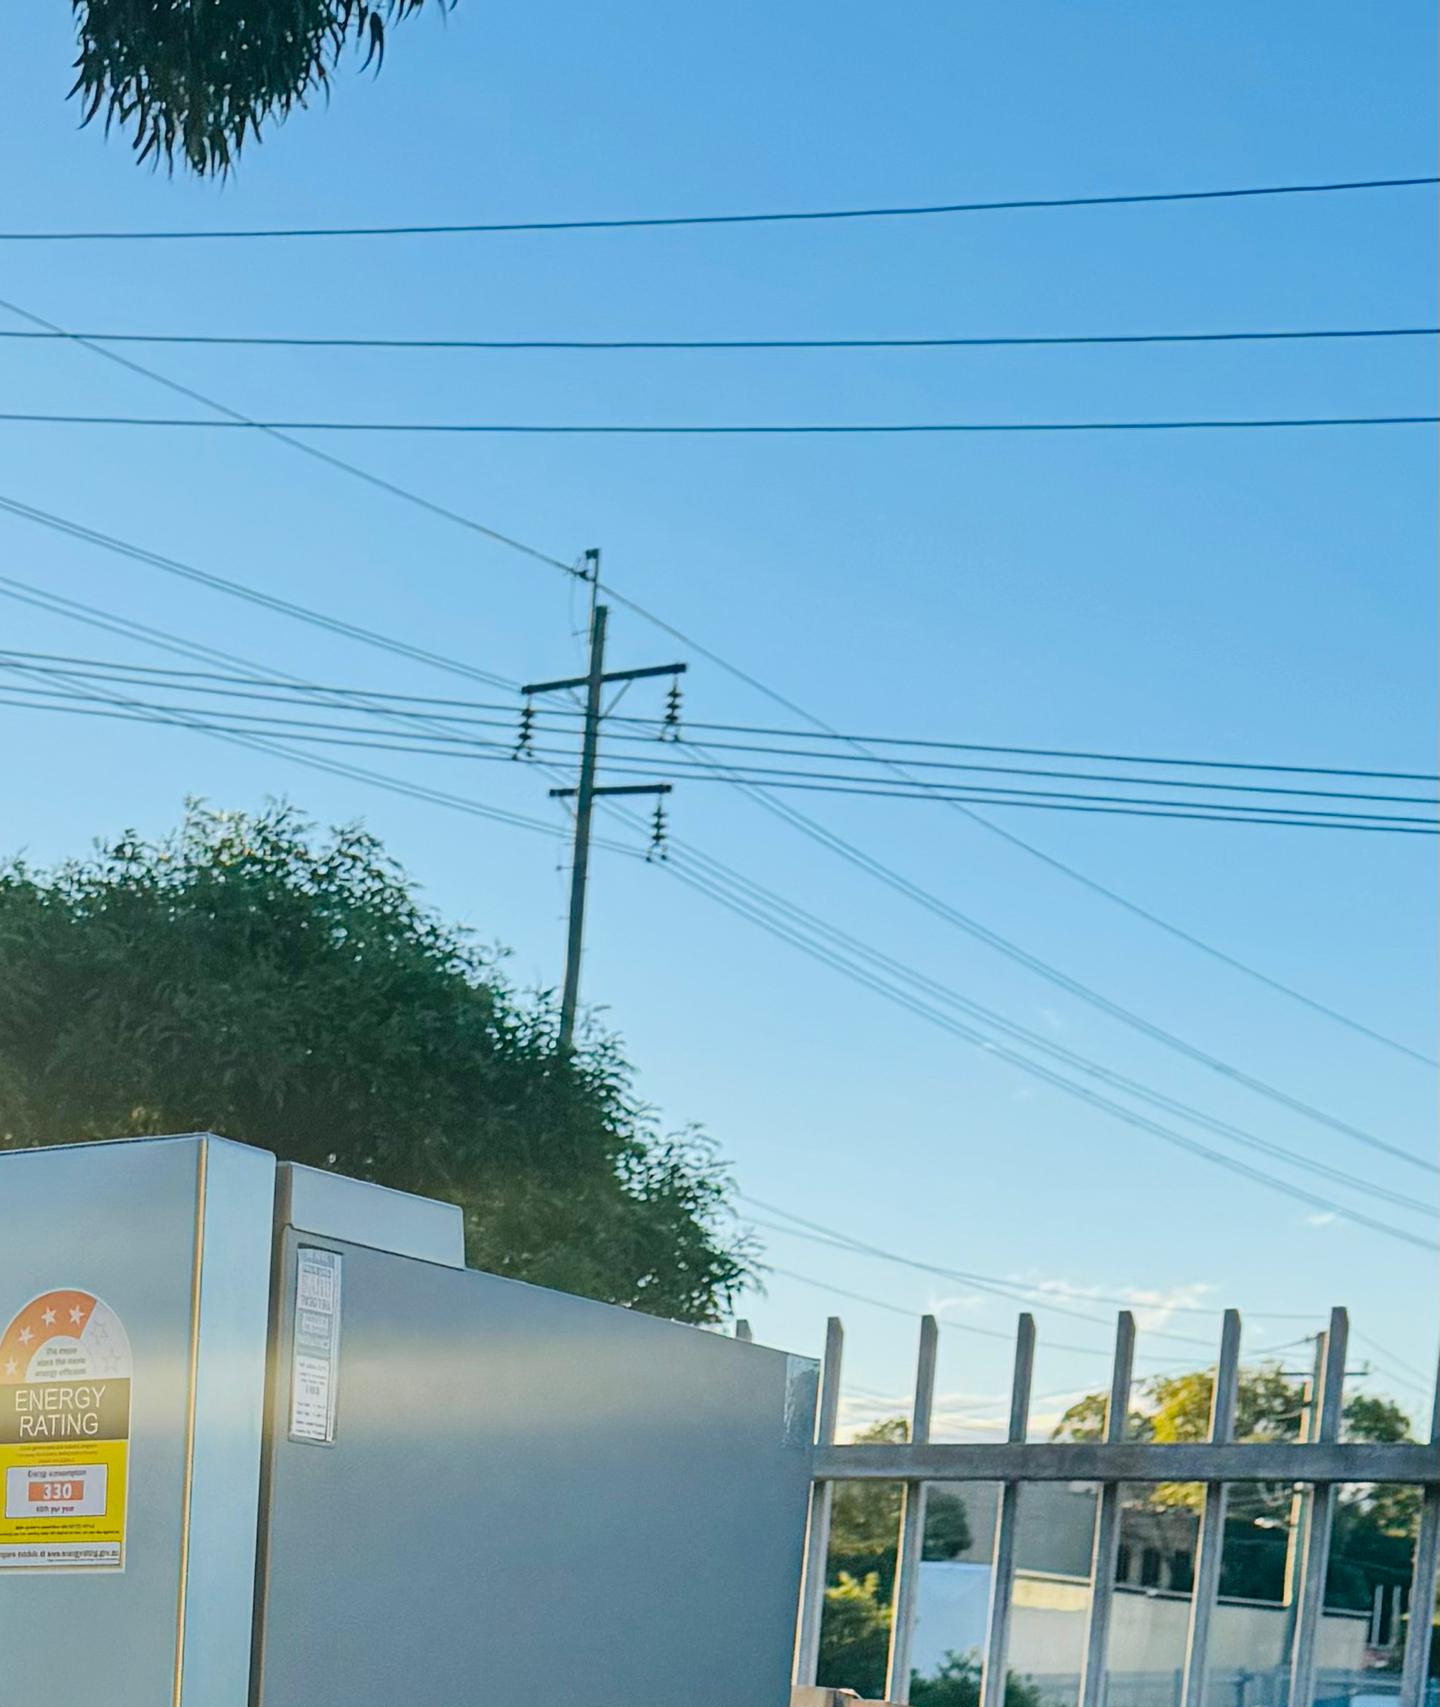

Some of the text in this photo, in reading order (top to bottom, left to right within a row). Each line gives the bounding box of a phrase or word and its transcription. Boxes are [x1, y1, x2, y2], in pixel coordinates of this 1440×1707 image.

[15, 1385, 106, 1411] ENERGY
[20, 1412, 99, 1438] RATING
[42, 1483, 72, 1500] 330
